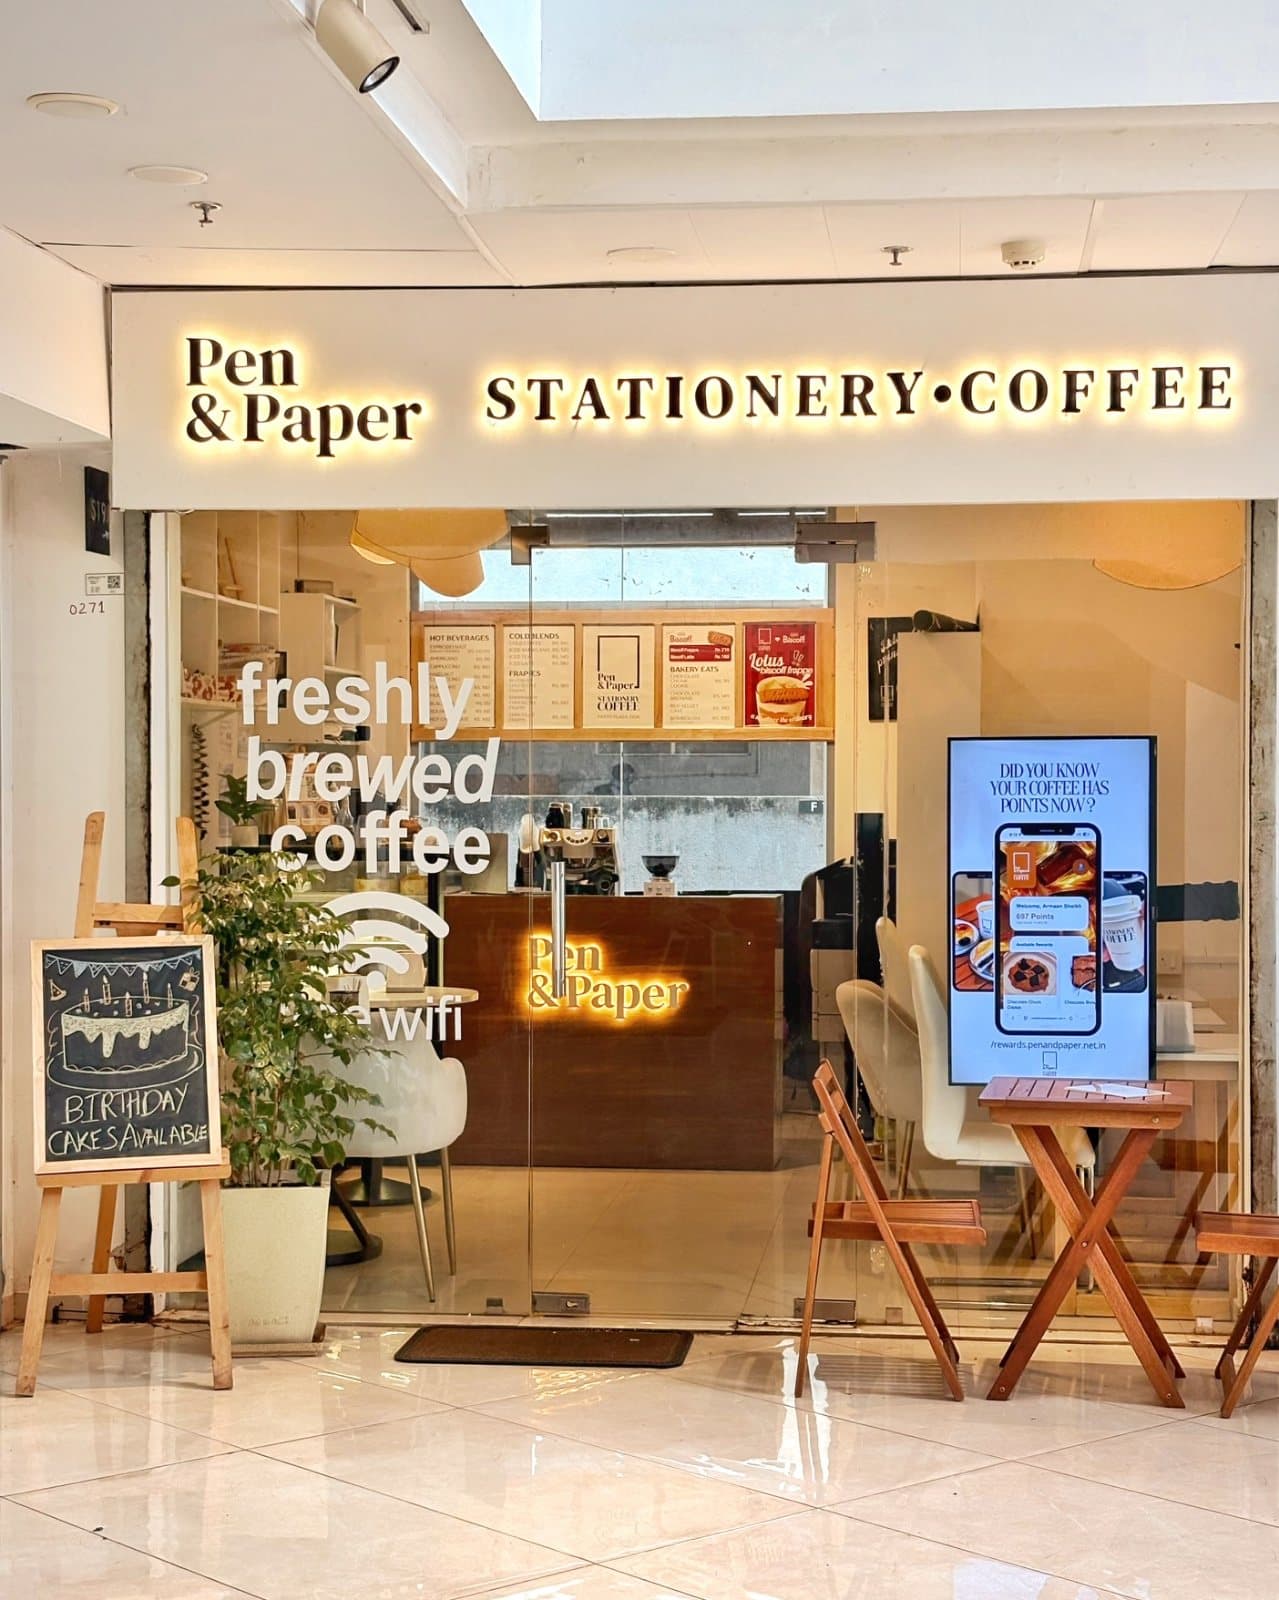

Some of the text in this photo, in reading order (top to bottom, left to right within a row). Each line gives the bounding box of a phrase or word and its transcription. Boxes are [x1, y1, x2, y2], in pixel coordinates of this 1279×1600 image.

[186, 337, 298, 387] Pen
[69, 600, 105, 615] 0271
[749, 652, 784, 672] Lotus
[597, 672, 615, 681] Pen
[236, 661, 475, 740] freshly
[597, 701, 638, 711] COFFEE
[246, 735, 501, 804] brewed
[1000, 762, 1100, 778] DID YOU KNOW
[990, 780, 1110, 796] YOUR COFFEE HAS
[1001, 797, 1049, 813] POINTS
[271, 810, 491, 875] coffee
[1031, 912, 1054, 920] Points
[529, 937, 600, 971] Pen
[378, 995, 462, 1041] wifi
[61, 1082, 189, 1125] BIRTHDAY
[48, 1124, 119, 1156] CAKES
